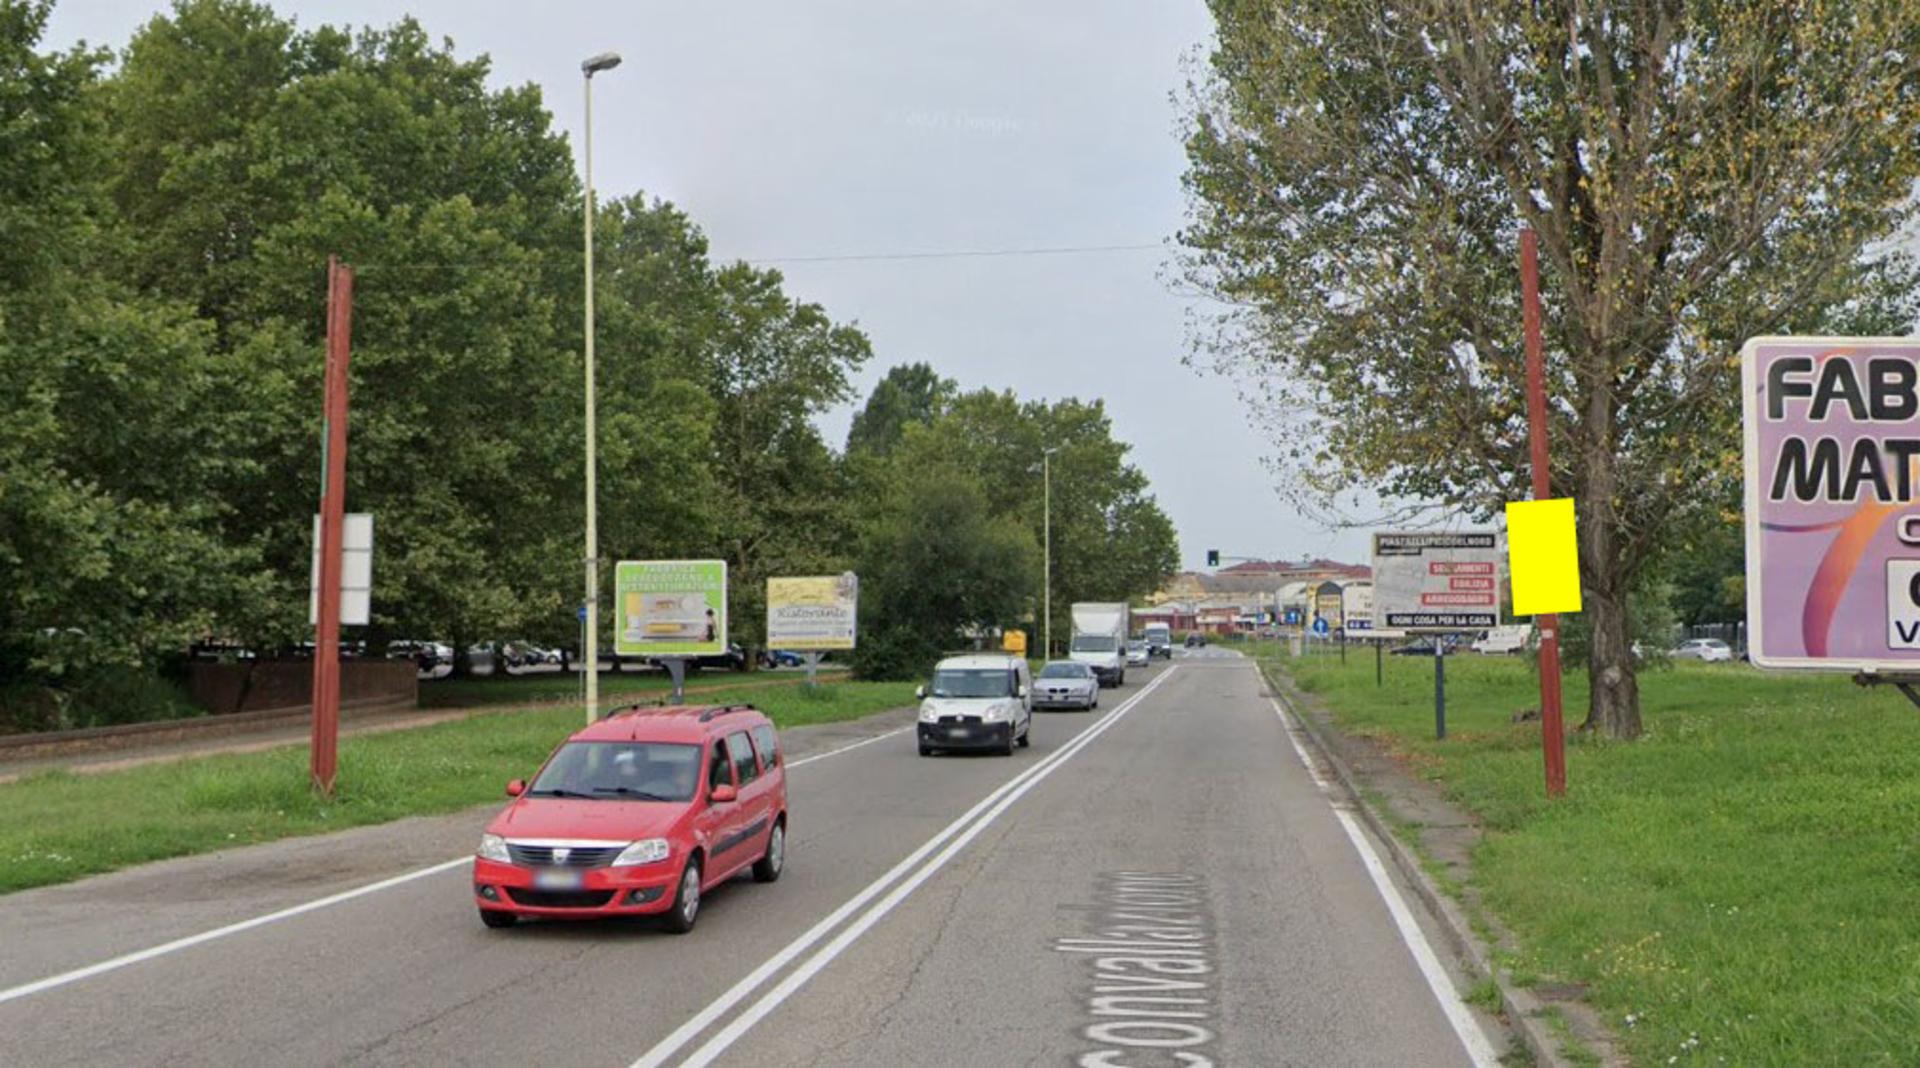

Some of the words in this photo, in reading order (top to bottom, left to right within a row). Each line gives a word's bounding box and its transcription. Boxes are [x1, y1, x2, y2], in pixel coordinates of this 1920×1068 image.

[1767, 356, 1919, 421] FAB
[1770, 437, 1920, 502] MAT
[1432, 563, 1489, 573] SEAMENTI
[1414, 615, 1436, 625] COSA
[1438, 615, 1455, 625] PER
[1469, 615, 1492, 625] CASA
